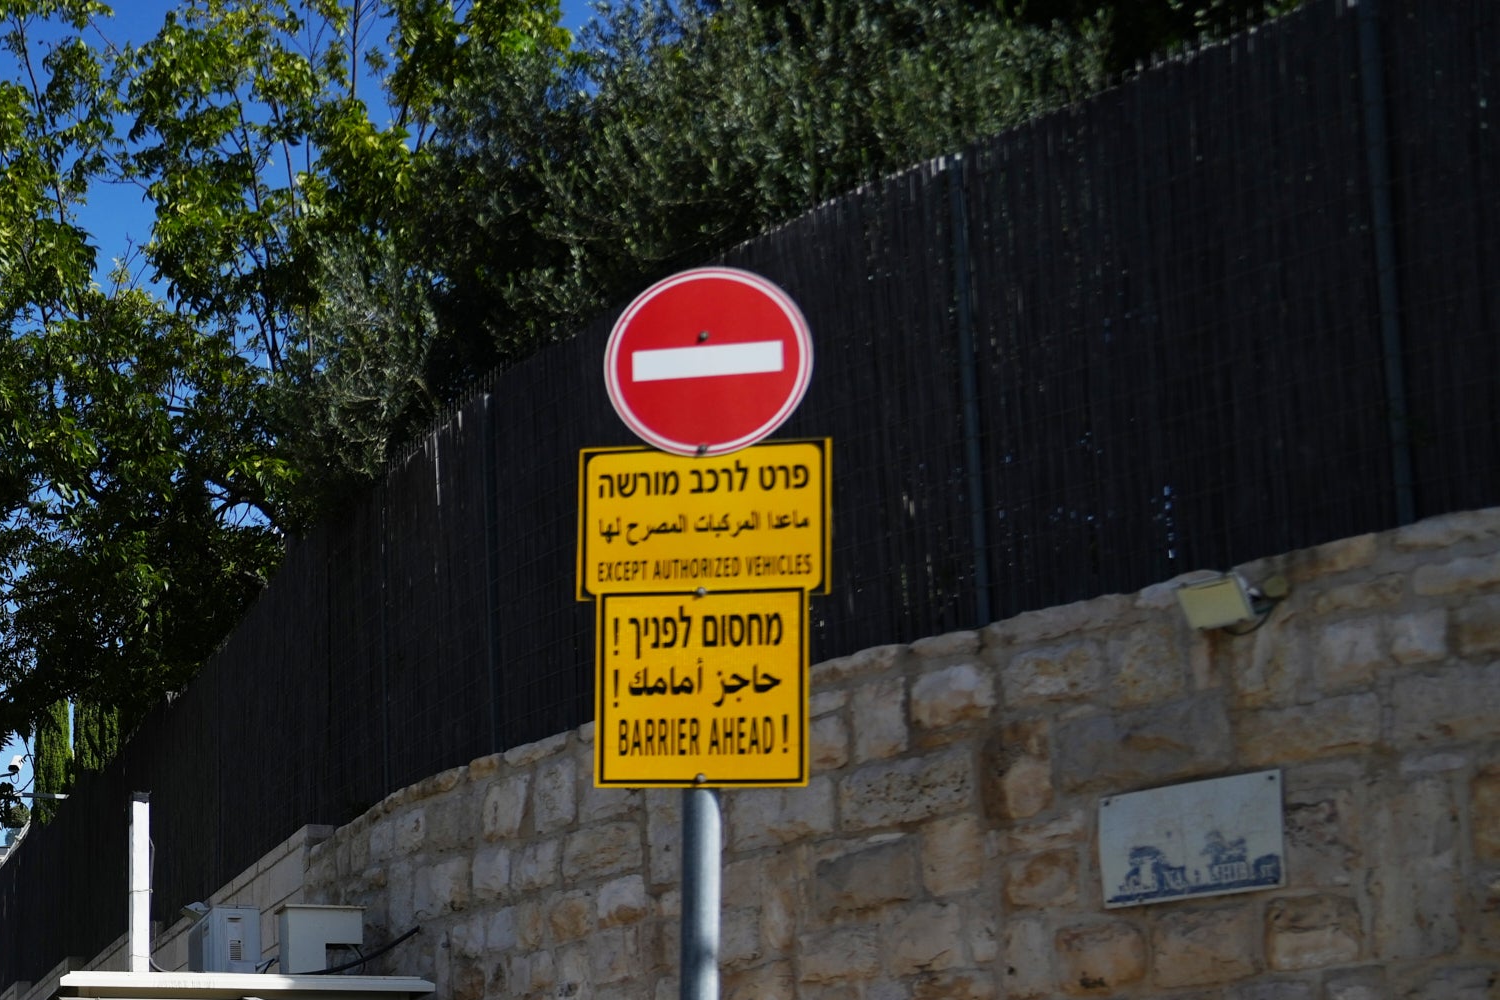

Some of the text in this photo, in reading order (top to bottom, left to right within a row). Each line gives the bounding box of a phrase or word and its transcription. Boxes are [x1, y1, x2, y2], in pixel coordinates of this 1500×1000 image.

[598, 460, 809, 499] פרט לרכב מורשה
[599, 517, 621, 543] لها
[694, 511, 760, 537] المركبات
[597, 553, 813, 582] EXCEPT AUTHORIZED VEHICLES
[702, 612, 783, 648] מחסום
[712, 664, 782, 707] حاجز
[618, 718, 700, 757] BARRIER
